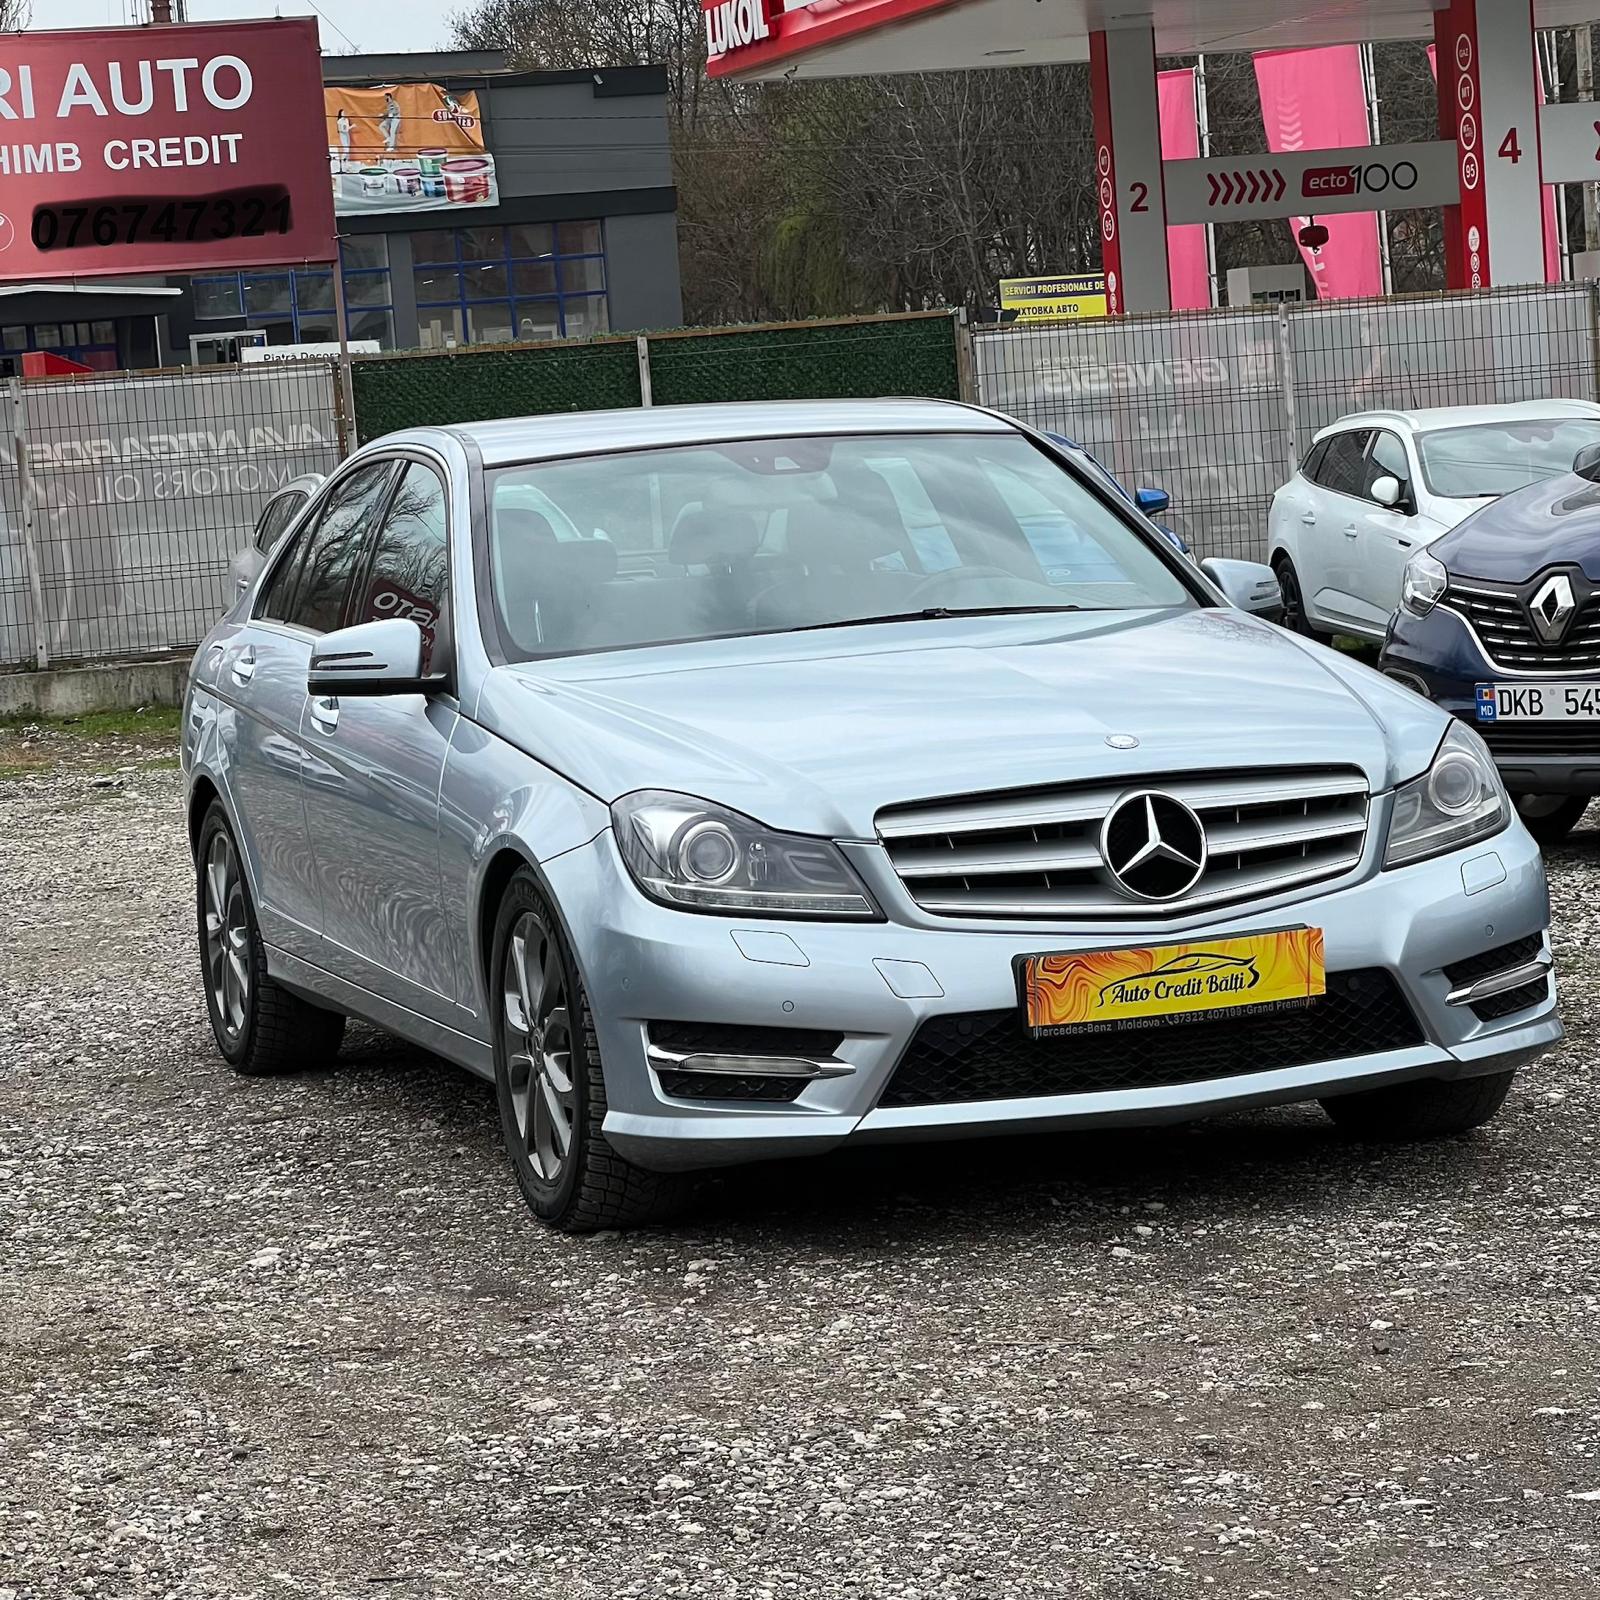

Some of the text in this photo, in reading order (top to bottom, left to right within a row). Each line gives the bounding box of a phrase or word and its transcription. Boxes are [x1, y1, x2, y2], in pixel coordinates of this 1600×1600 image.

[705, 0, 769, 56] LUKOIL
[57, 55, 253, 118] AUTO
[104, 134, 243, 170] CREDIT
[1498, 128, 1522, 164] 4
[1465, 164, 1475, 178] 95
[1130, 183, 1149, 212] 2
[31, 195, 291, 250] 076747321
[1005, 286, 1036, 296] SERVICII
[1037, 282, 1094, 293] PROFESIONALE
[1095, 280, 1105, 290] DE
[1010, 304, 1079, 316] ХТОВКА АВТО
[1480, 705, 1494, 716] MD
[1497, 688, 1544, 716] DKB
[1111, 984, 1151, 1004] Auto
[1155, 978, 1203, 999] Credit
[1033, 1022, 1113, 1038] Mercedes-Benz
[1117, 1019, 1160, 1031] Moldova
[1246, 1001, 1275, 1015] Grand
